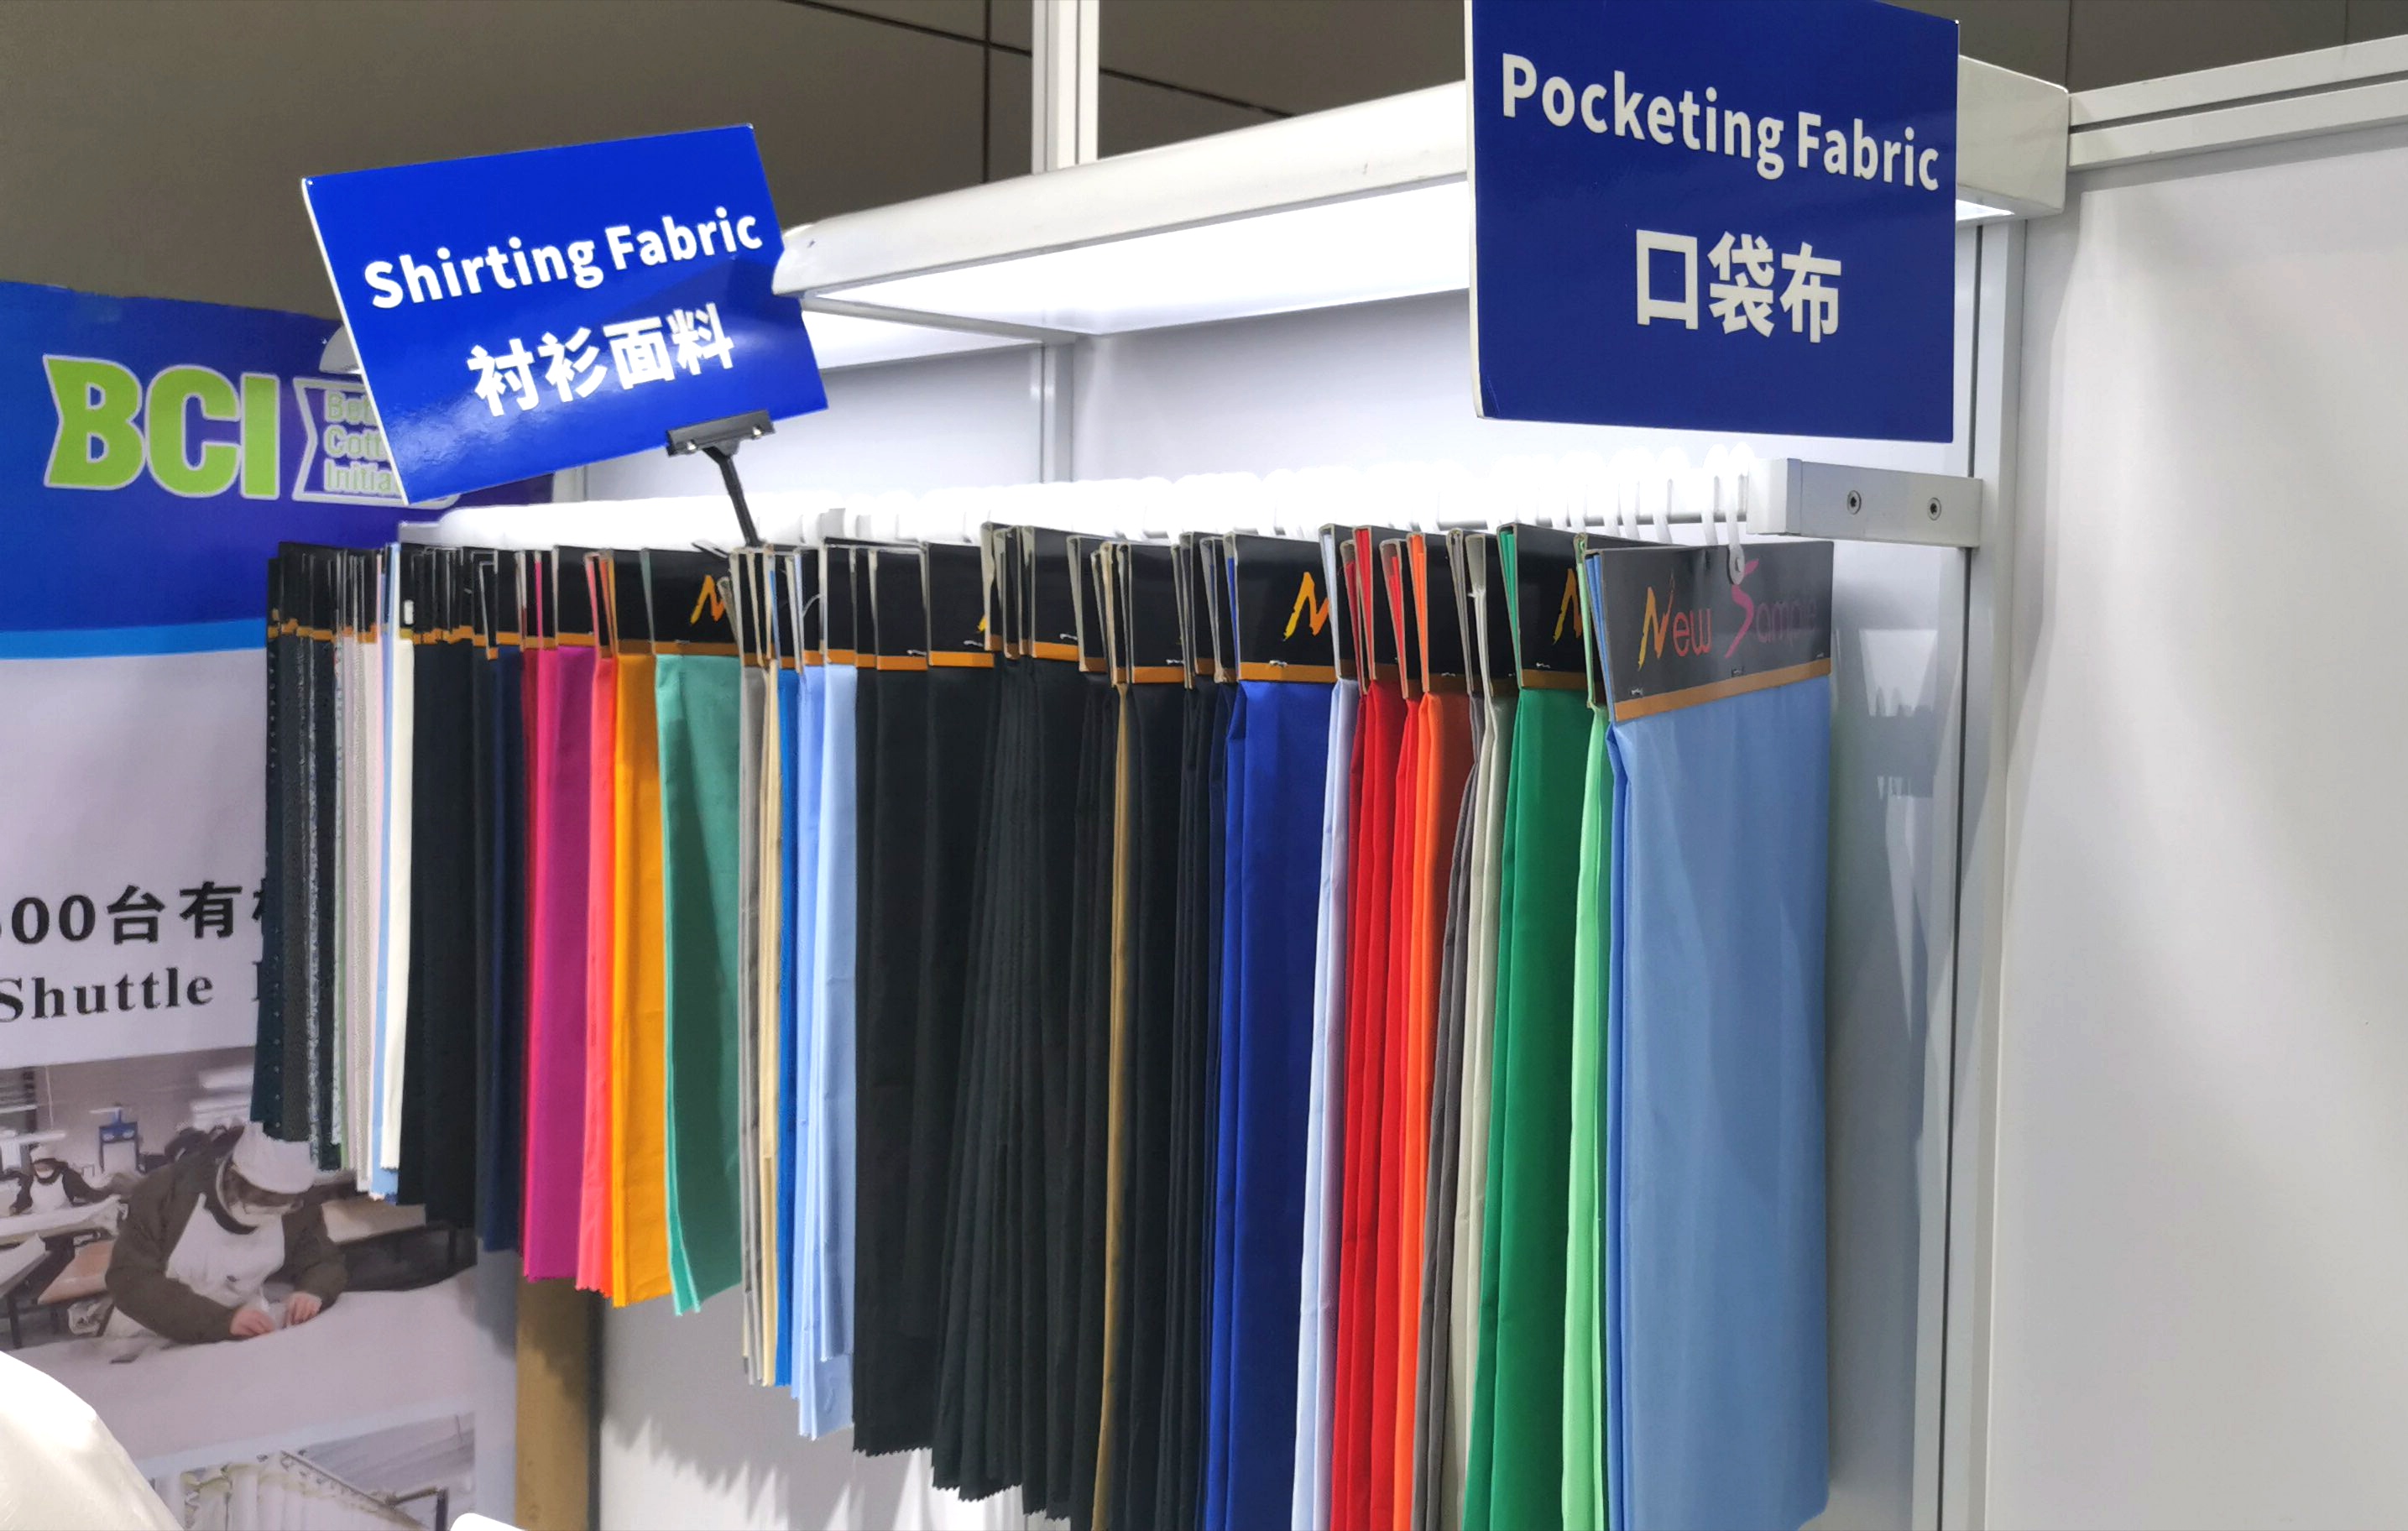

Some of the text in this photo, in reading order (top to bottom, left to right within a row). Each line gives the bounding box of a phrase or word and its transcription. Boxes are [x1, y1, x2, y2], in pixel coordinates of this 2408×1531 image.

[1502, 52, 1940, 191] Pocketing Fabric
[363, 206, 764, 310] Shirting Fabric
[1636, 228, 1841, 344] 口袋布
[325, 391, 377, 424] Bet
[467, 302, 734, 417] 衬衫面料
[43, 354, 280, 499] BCI
[324, 425, 387, 459] Cott
[1638, 568, 1712, 671] New
[0, 879, 264, 945] 00台有
[0, 967, 213, 1022] Shuttle
